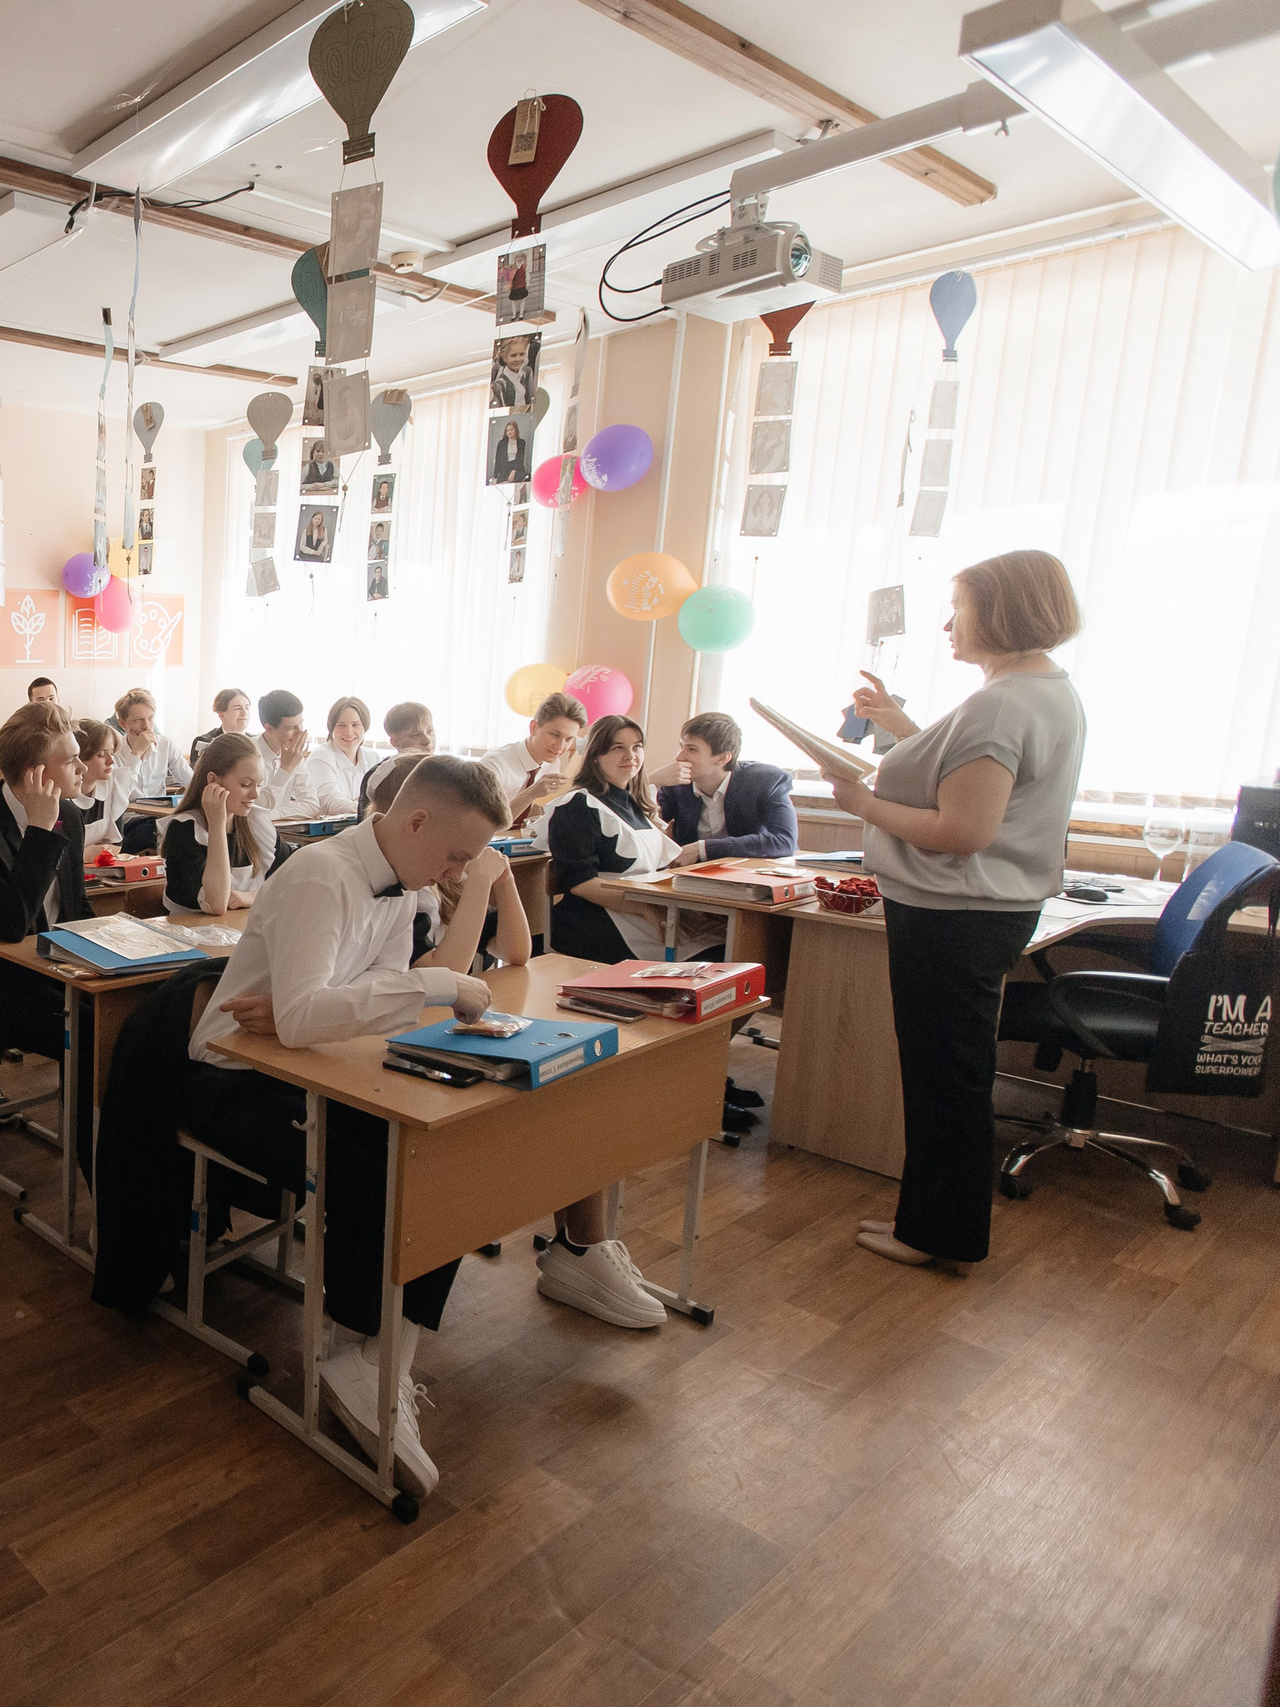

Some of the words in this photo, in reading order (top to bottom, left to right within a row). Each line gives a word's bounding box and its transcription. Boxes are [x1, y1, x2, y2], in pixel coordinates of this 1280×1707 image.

[1254, 995, 1272, 1022] A
[1204, 1022, 1269, 1036] TEACHER
[1196, 1053, 1239, 1065] WHAT'S
